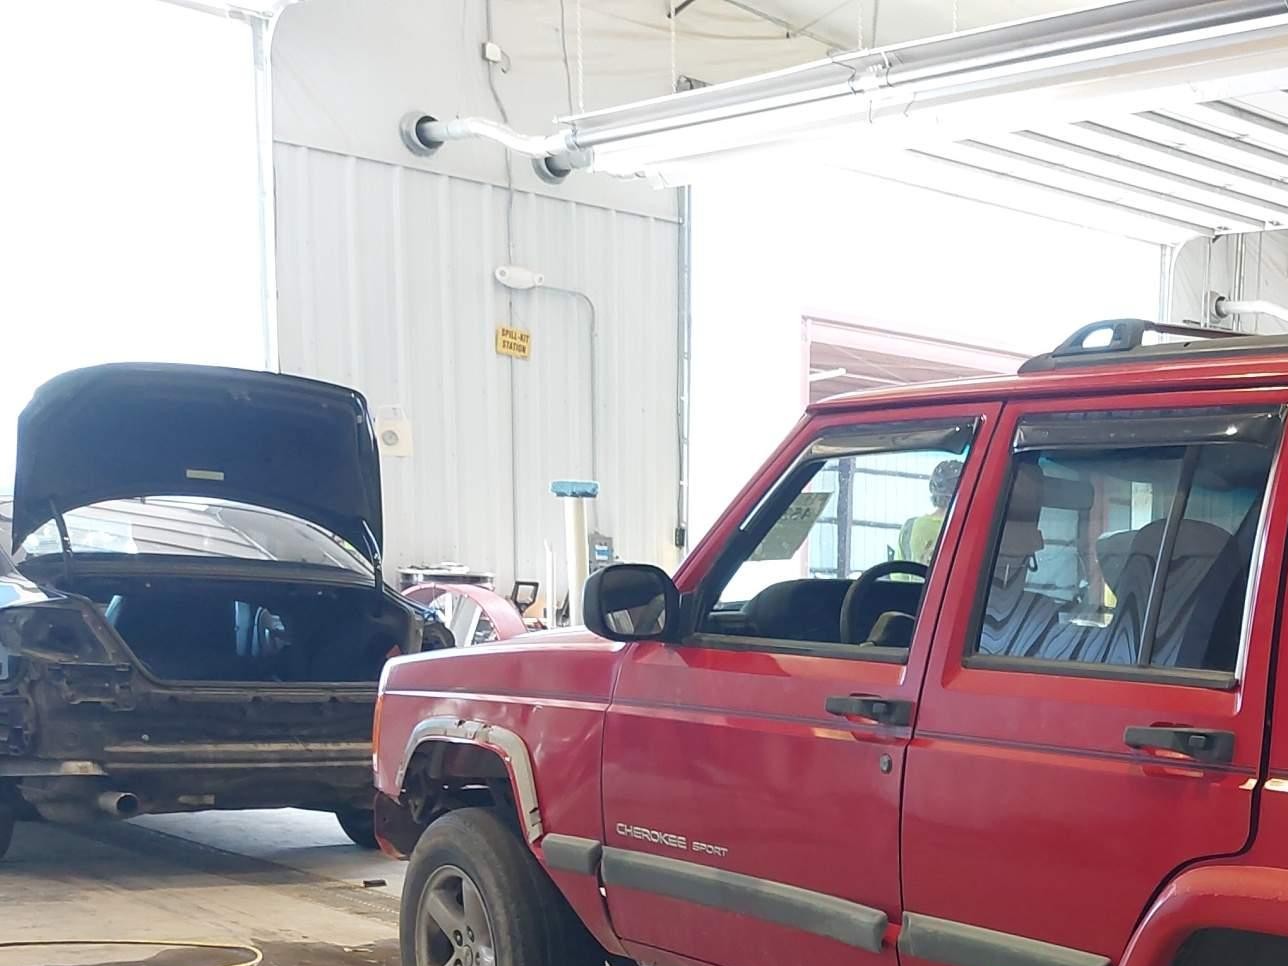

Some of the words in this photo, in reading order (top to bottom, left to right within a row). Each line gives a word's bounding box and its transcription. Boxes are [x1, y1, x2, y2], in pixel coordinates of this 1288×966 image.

[502, 339, 527, 354] STATION
[616, 822, 688, 850] CHEROKEE
[692, 841, 729, 857] SPORT
